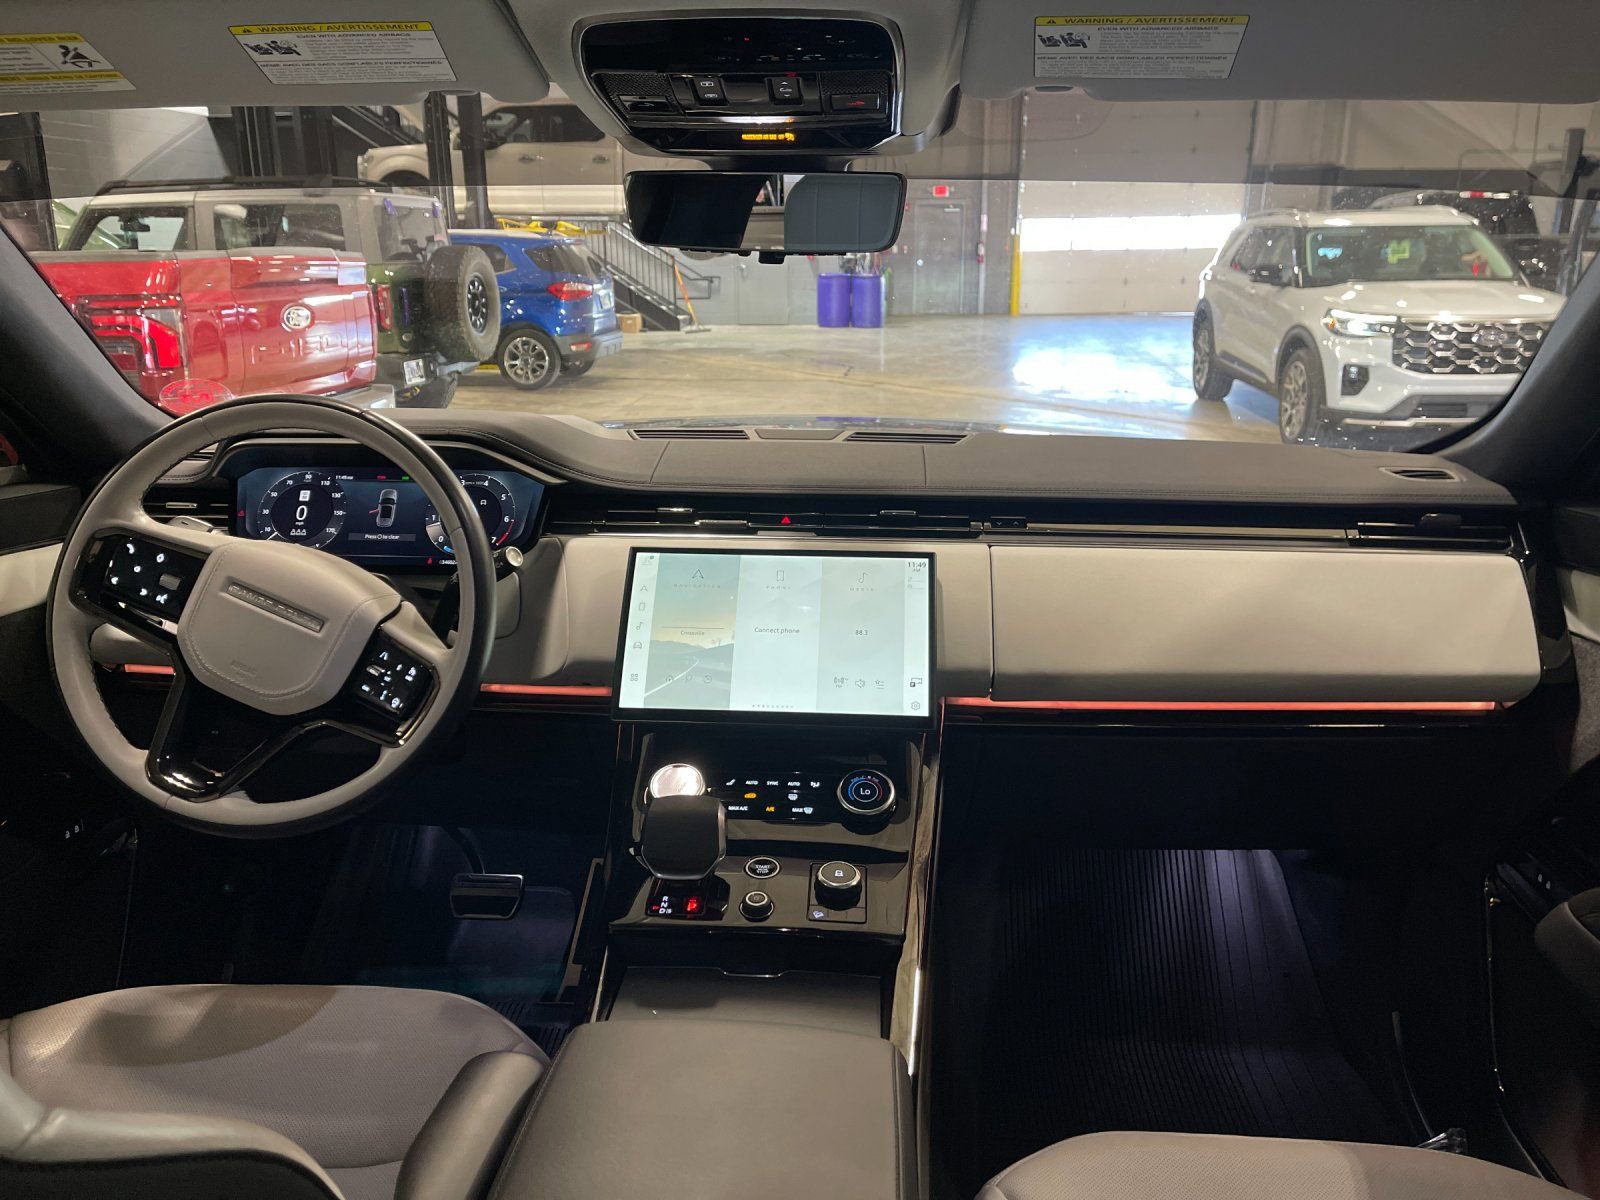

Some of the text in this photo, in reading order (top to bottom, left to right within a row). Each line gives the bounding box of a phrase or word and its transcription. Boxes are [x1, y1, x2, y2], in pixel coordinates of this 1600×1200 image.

[258, 25, 316, 33] WARNING
[326, 23, 419, 32] AVERTISSEMENT
[501, 493, 506, 501] 5
[296, 505, 308, 521] 0
[504, 515, 510, 523] 6
[438, 535, 444, 543] 0
[491, 536, 497, 544] 7
[754, 626, 800, 635] Connect phone
[860, 787, 871, 796] Lo
